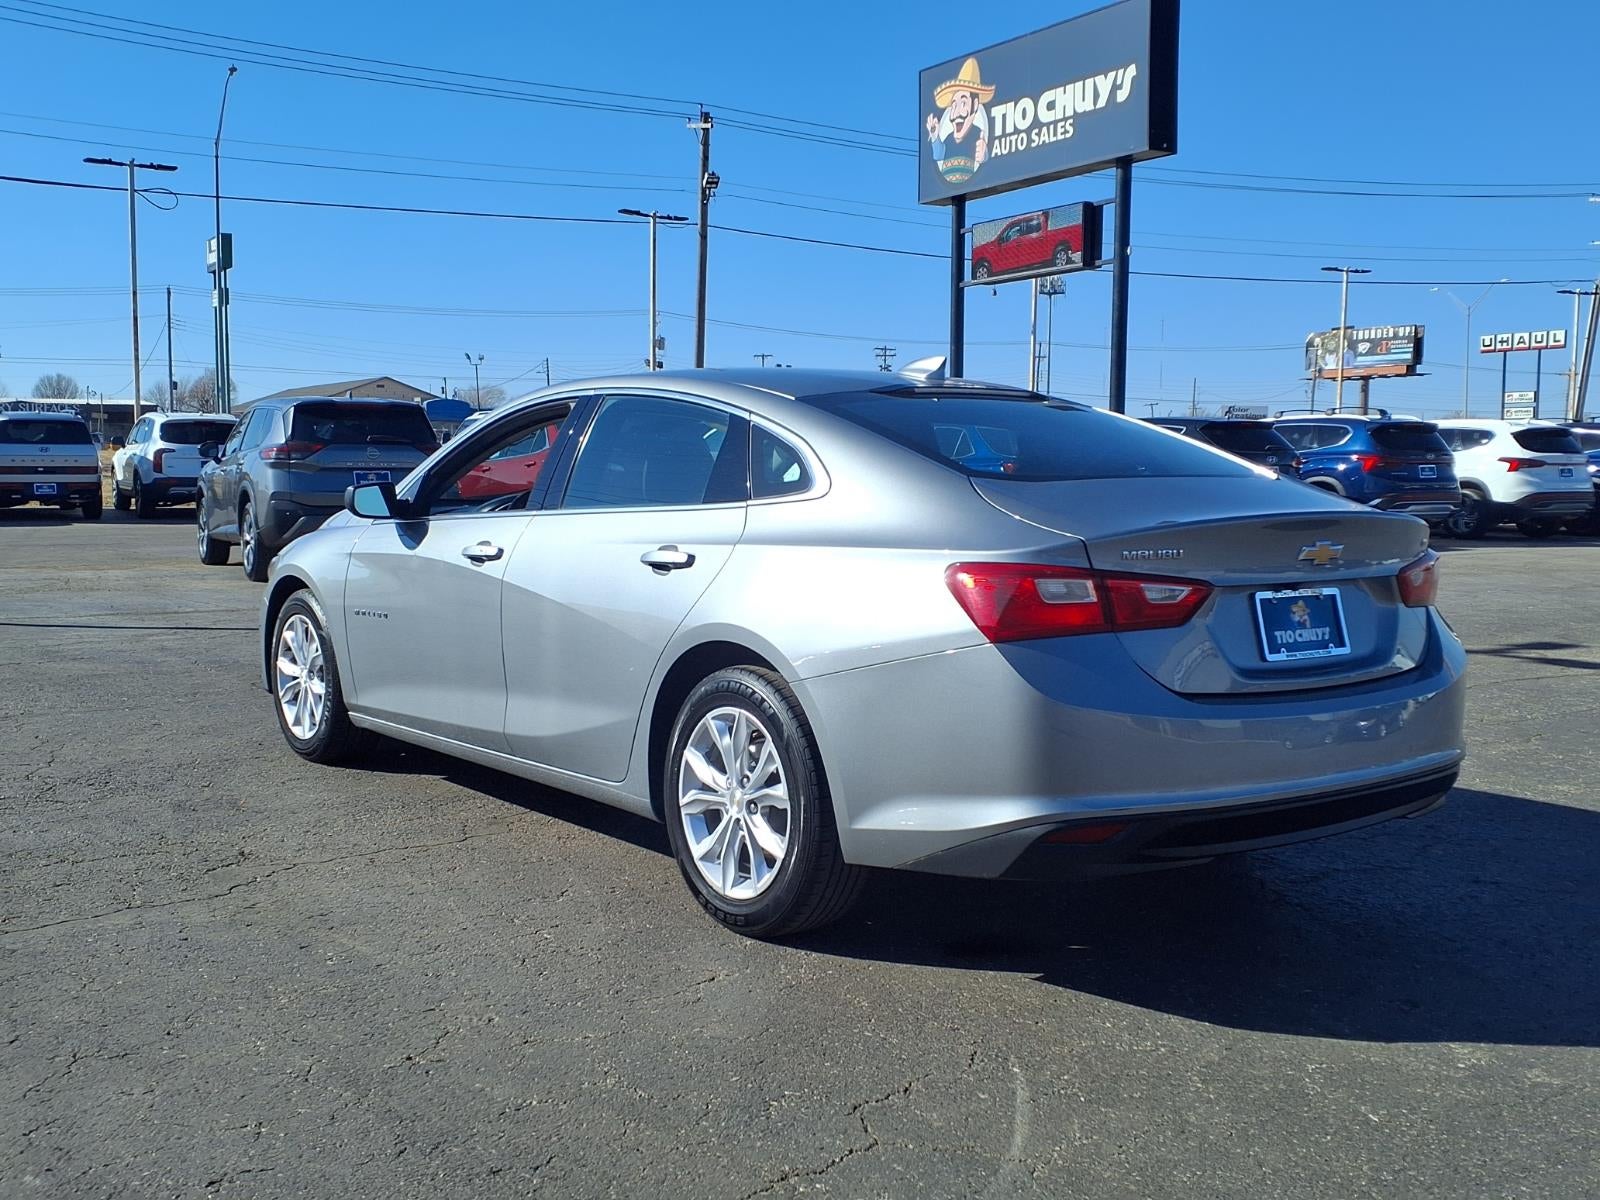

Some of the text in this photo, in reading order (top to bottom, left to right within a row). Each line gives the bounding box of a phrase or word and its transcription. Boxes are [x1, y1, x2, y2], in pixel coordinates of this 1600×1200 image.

[990, 63, 1137, 137] TIO CHUY'S
[991, 119, 1074, 158] AUTO SALES
[1353, 326, 1415, 340] THUNDER UP!
[18, 403, 80, 412] SURFACES
[1122, 550, 1184, 560] MALIBU
[1274, 630, 1295, 644] TIO
